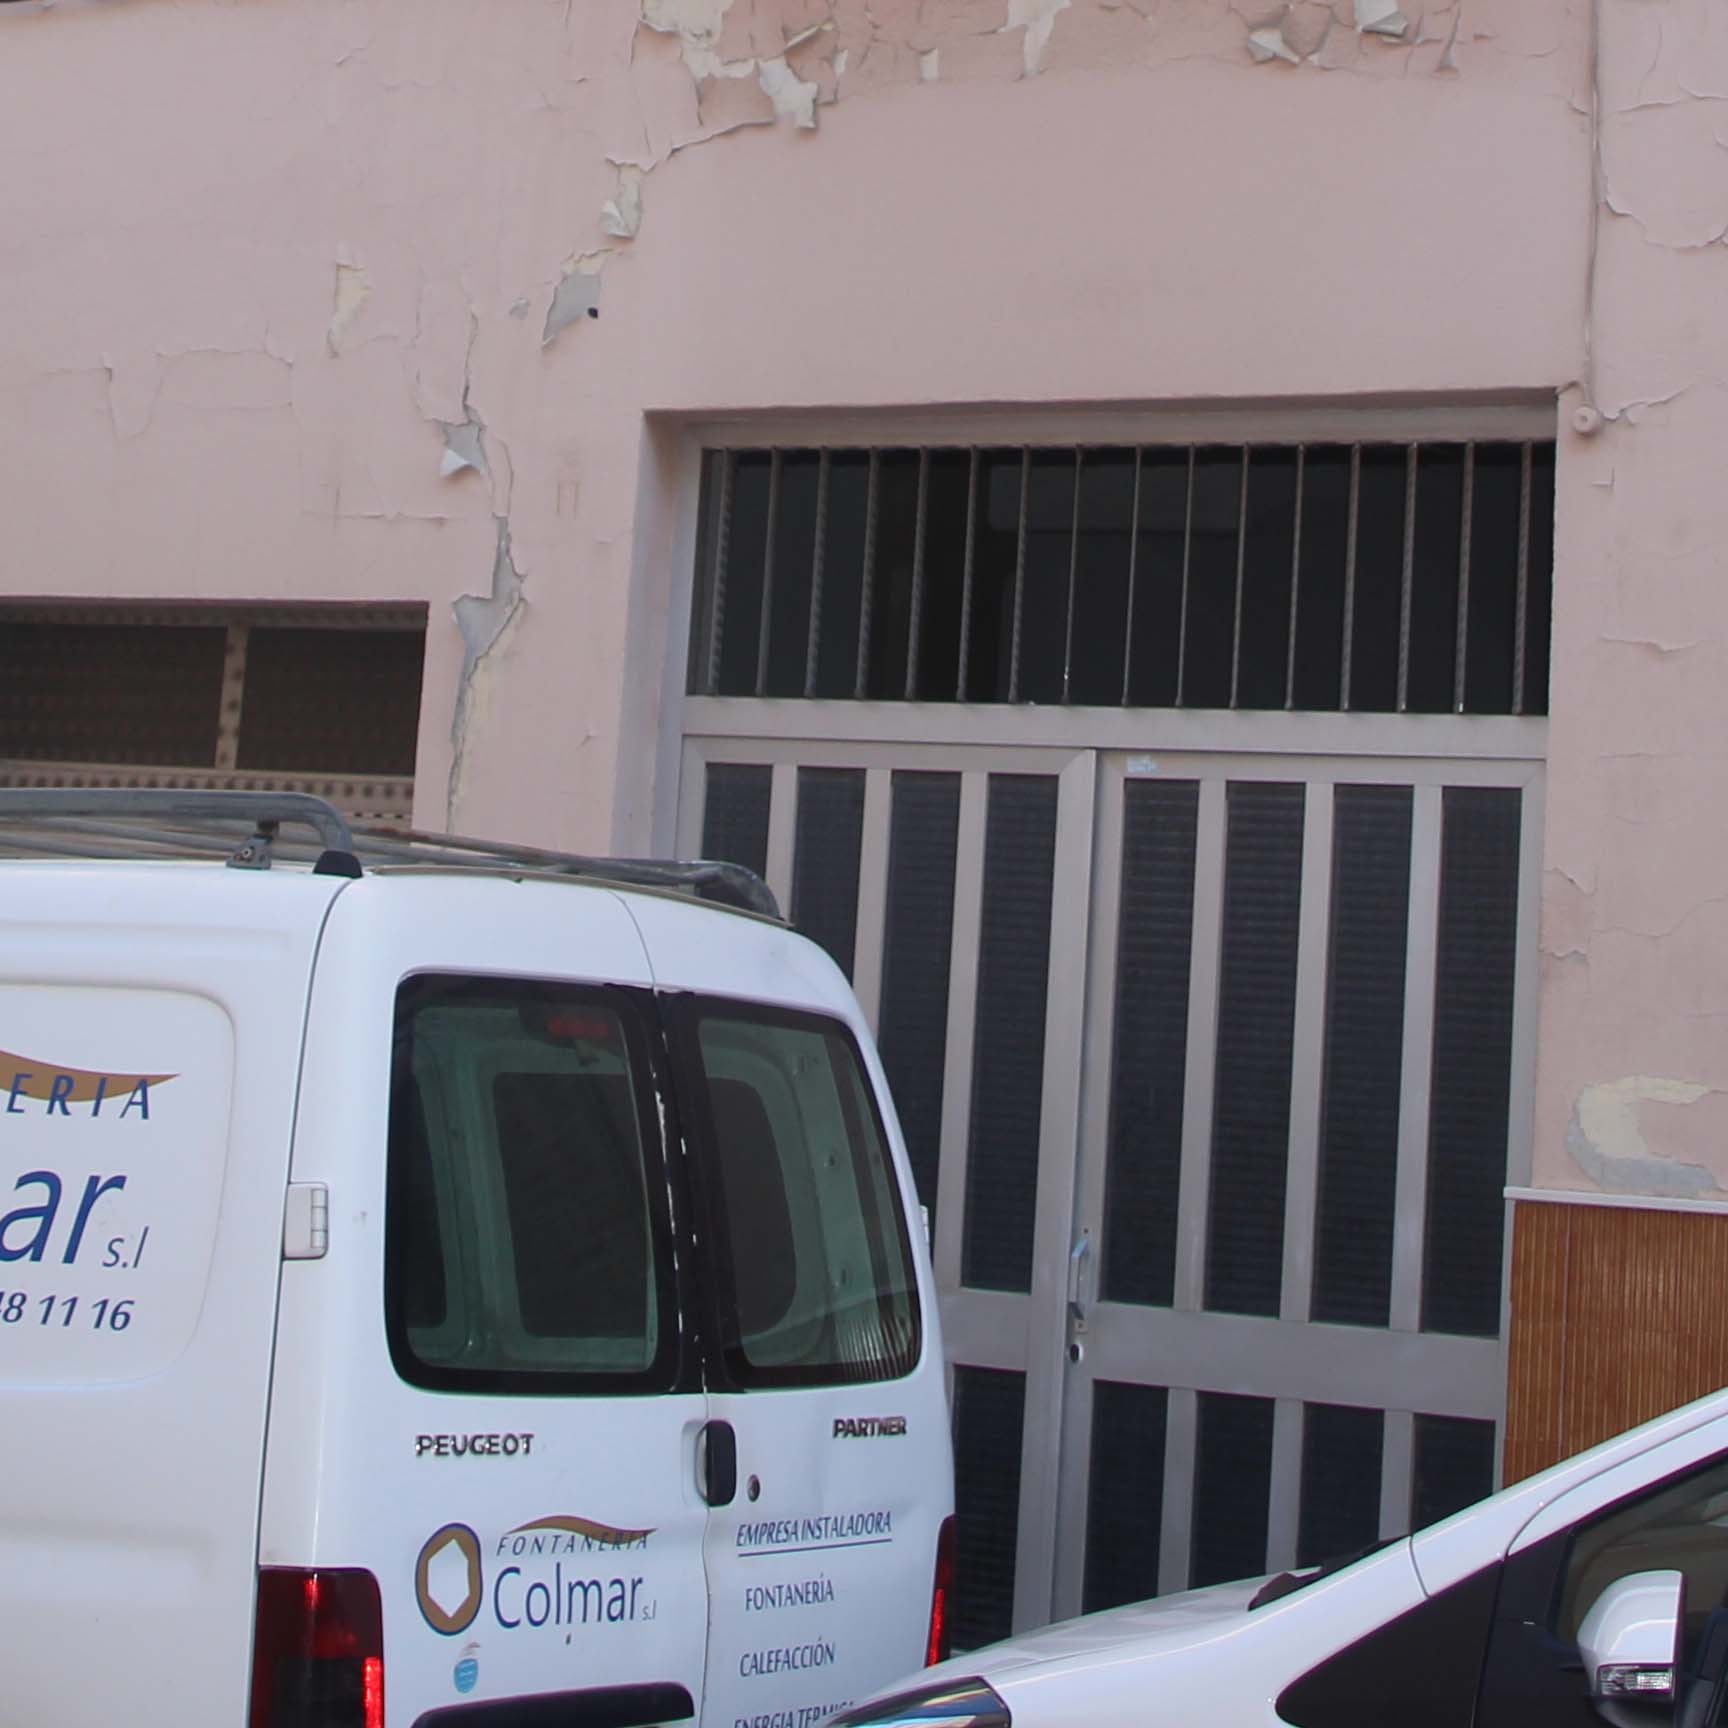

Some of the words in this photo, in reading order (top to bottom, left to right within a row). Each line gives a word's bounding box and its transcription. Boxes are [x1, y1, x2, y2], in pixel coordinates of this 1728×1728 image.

[38, 1295, 79, 1327] 11
[91, 1299, 135, 1332] 16
[415, 1433, 534, 1456] PEUGEOT
[833, 1416, 907, 1438] PARTNER
[496, 1533, 648, 1557] FONTANERIA
[736, 1521, 799, 1547] EMPRESA
[801, 1511, 892, 1541] INSTALADORA
[494, 1561, 643, 1629] Colmar
[745, 1571, 834, 1611] FONTANERÍA
[740, 1635, 835, 1677] CALEFACCIÓN
